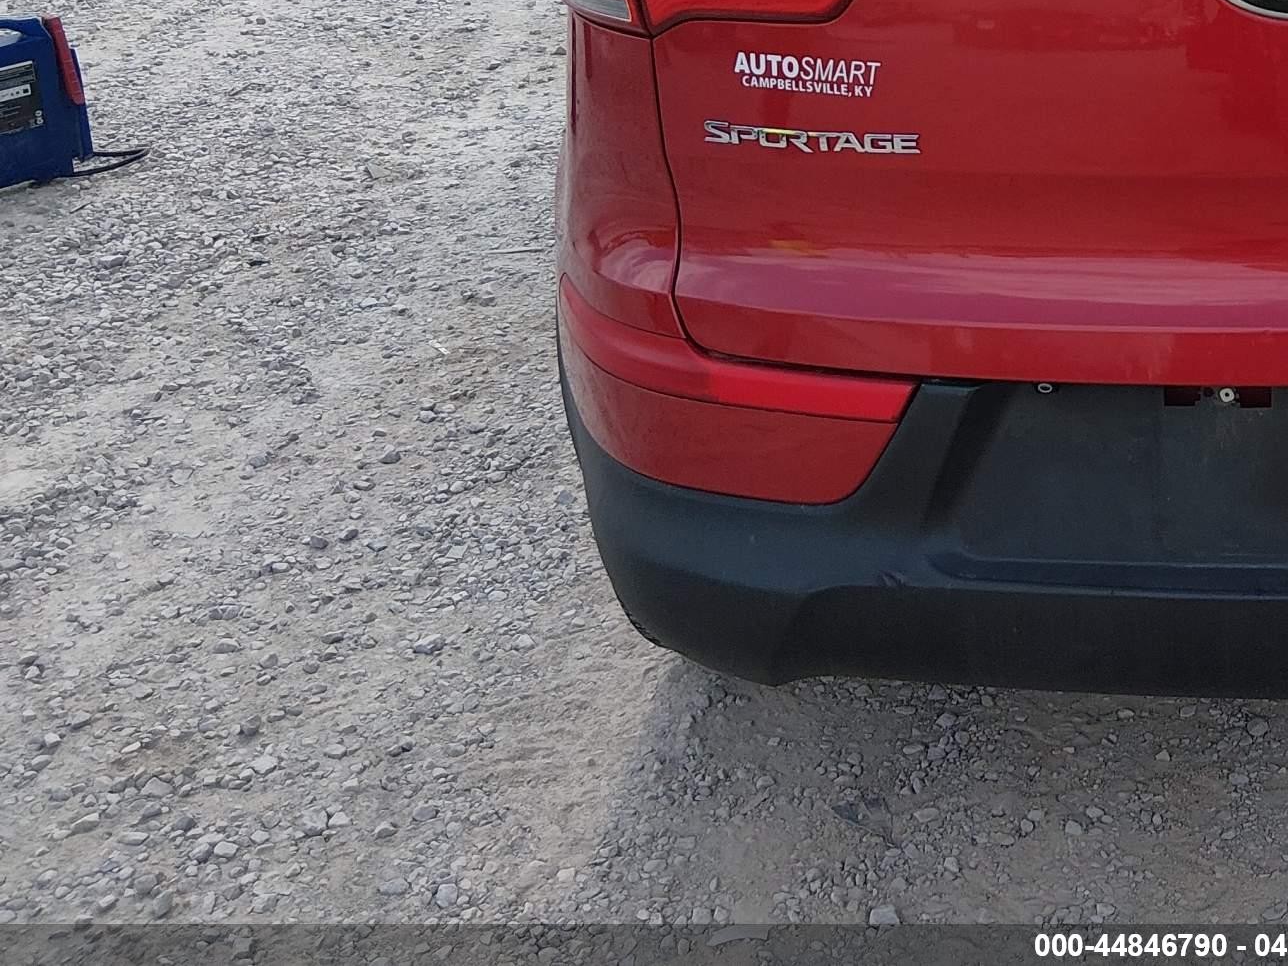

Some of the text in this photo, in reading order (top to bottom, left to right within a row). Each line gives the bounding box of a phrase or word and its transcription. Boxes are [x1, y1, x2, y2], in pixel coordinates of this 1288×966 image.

[742, 75, 873, 97] CAMPBELLSVILLE, KY
[703, 120, 921, 154] SPORTAGE
